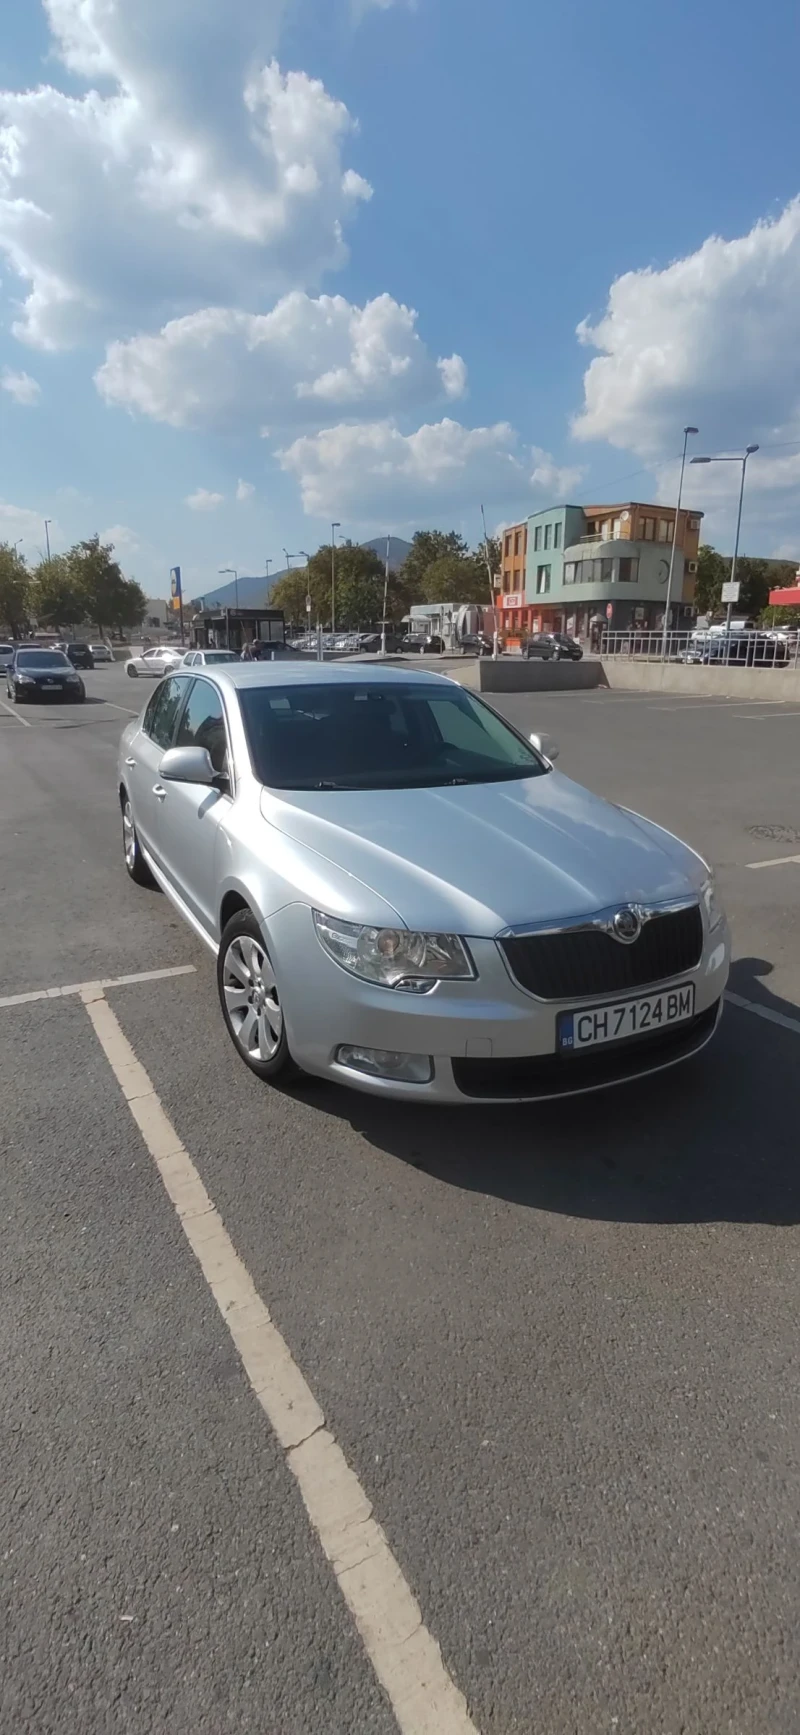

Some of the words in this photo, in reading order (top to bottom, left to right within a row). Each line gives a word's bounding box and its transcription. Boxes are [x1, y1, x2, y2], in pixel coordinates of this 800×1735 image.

[577, 1012, 608, 1042] CH
[613, 998, 662, 1035] 7124
[666, 989, 691, 1021] BM
[562, 1036, 573, 1046] BG
